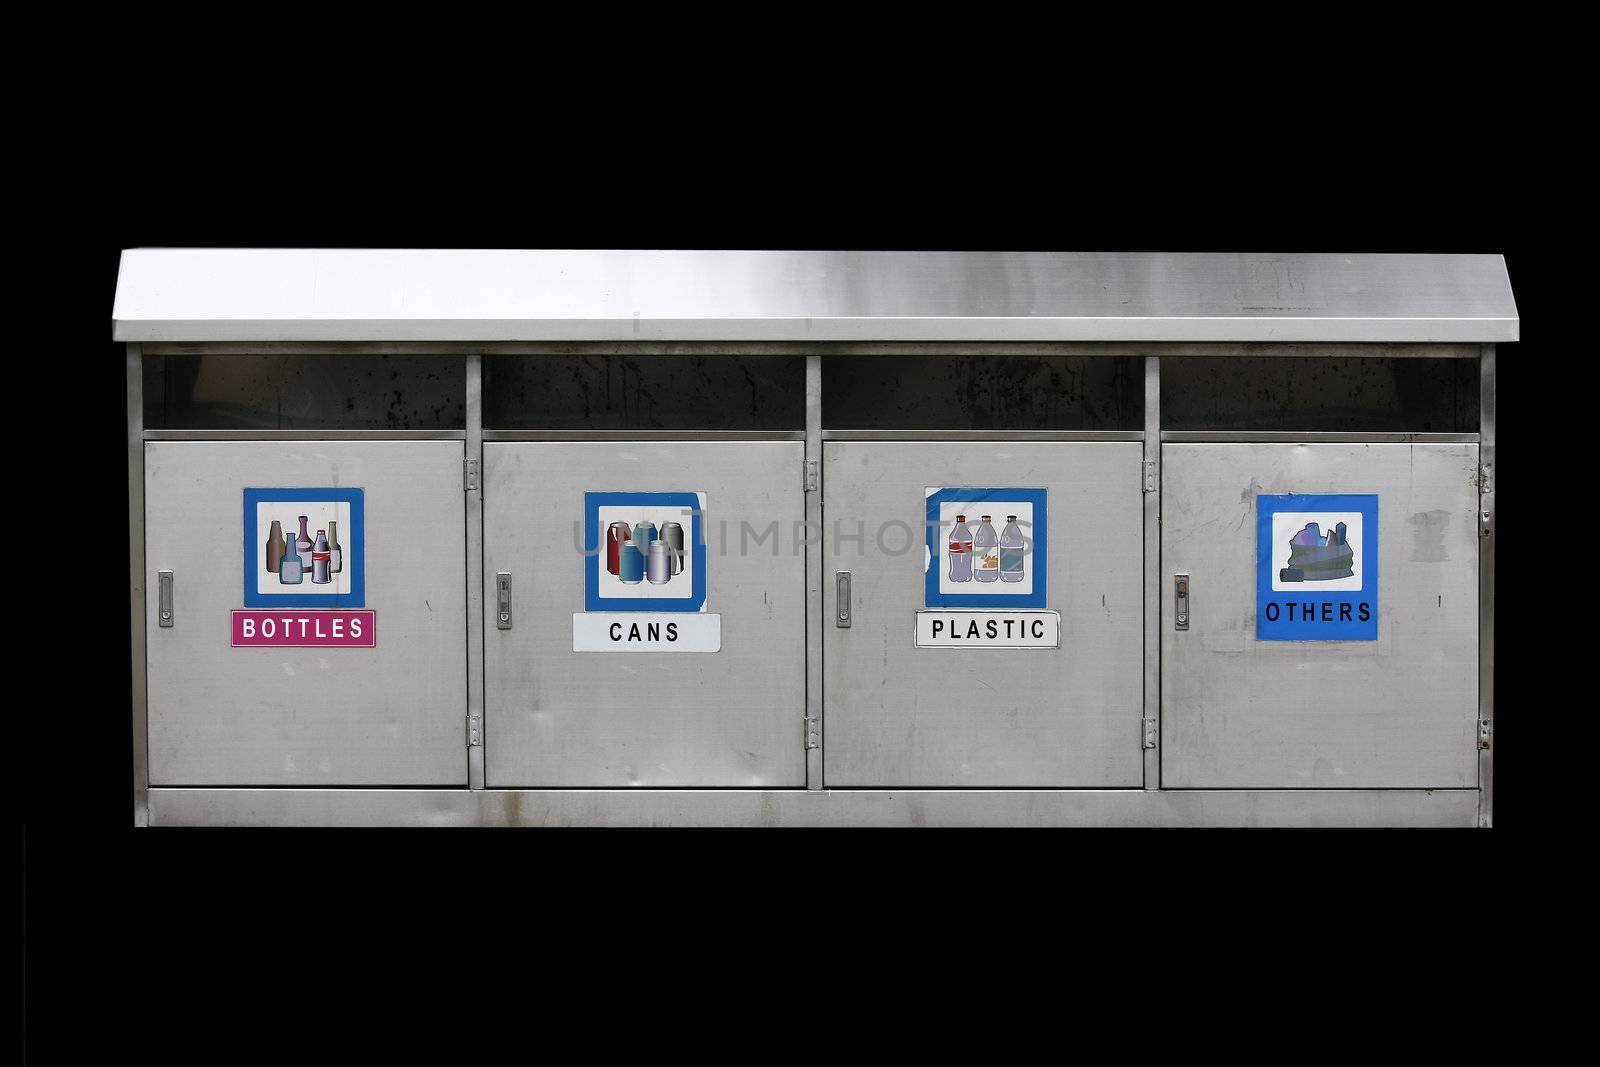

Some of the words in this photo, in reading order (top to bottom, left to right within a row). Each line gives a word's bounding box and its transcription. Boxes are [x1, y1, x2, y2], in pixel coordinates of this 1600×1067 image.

[1265, 602, 1372, 622] OTHERS
[242, 618, 364, 639] BOTTLES
[609, 622, 679, 642] CANS
[931, 619, 1045, 640] PLASTIC
